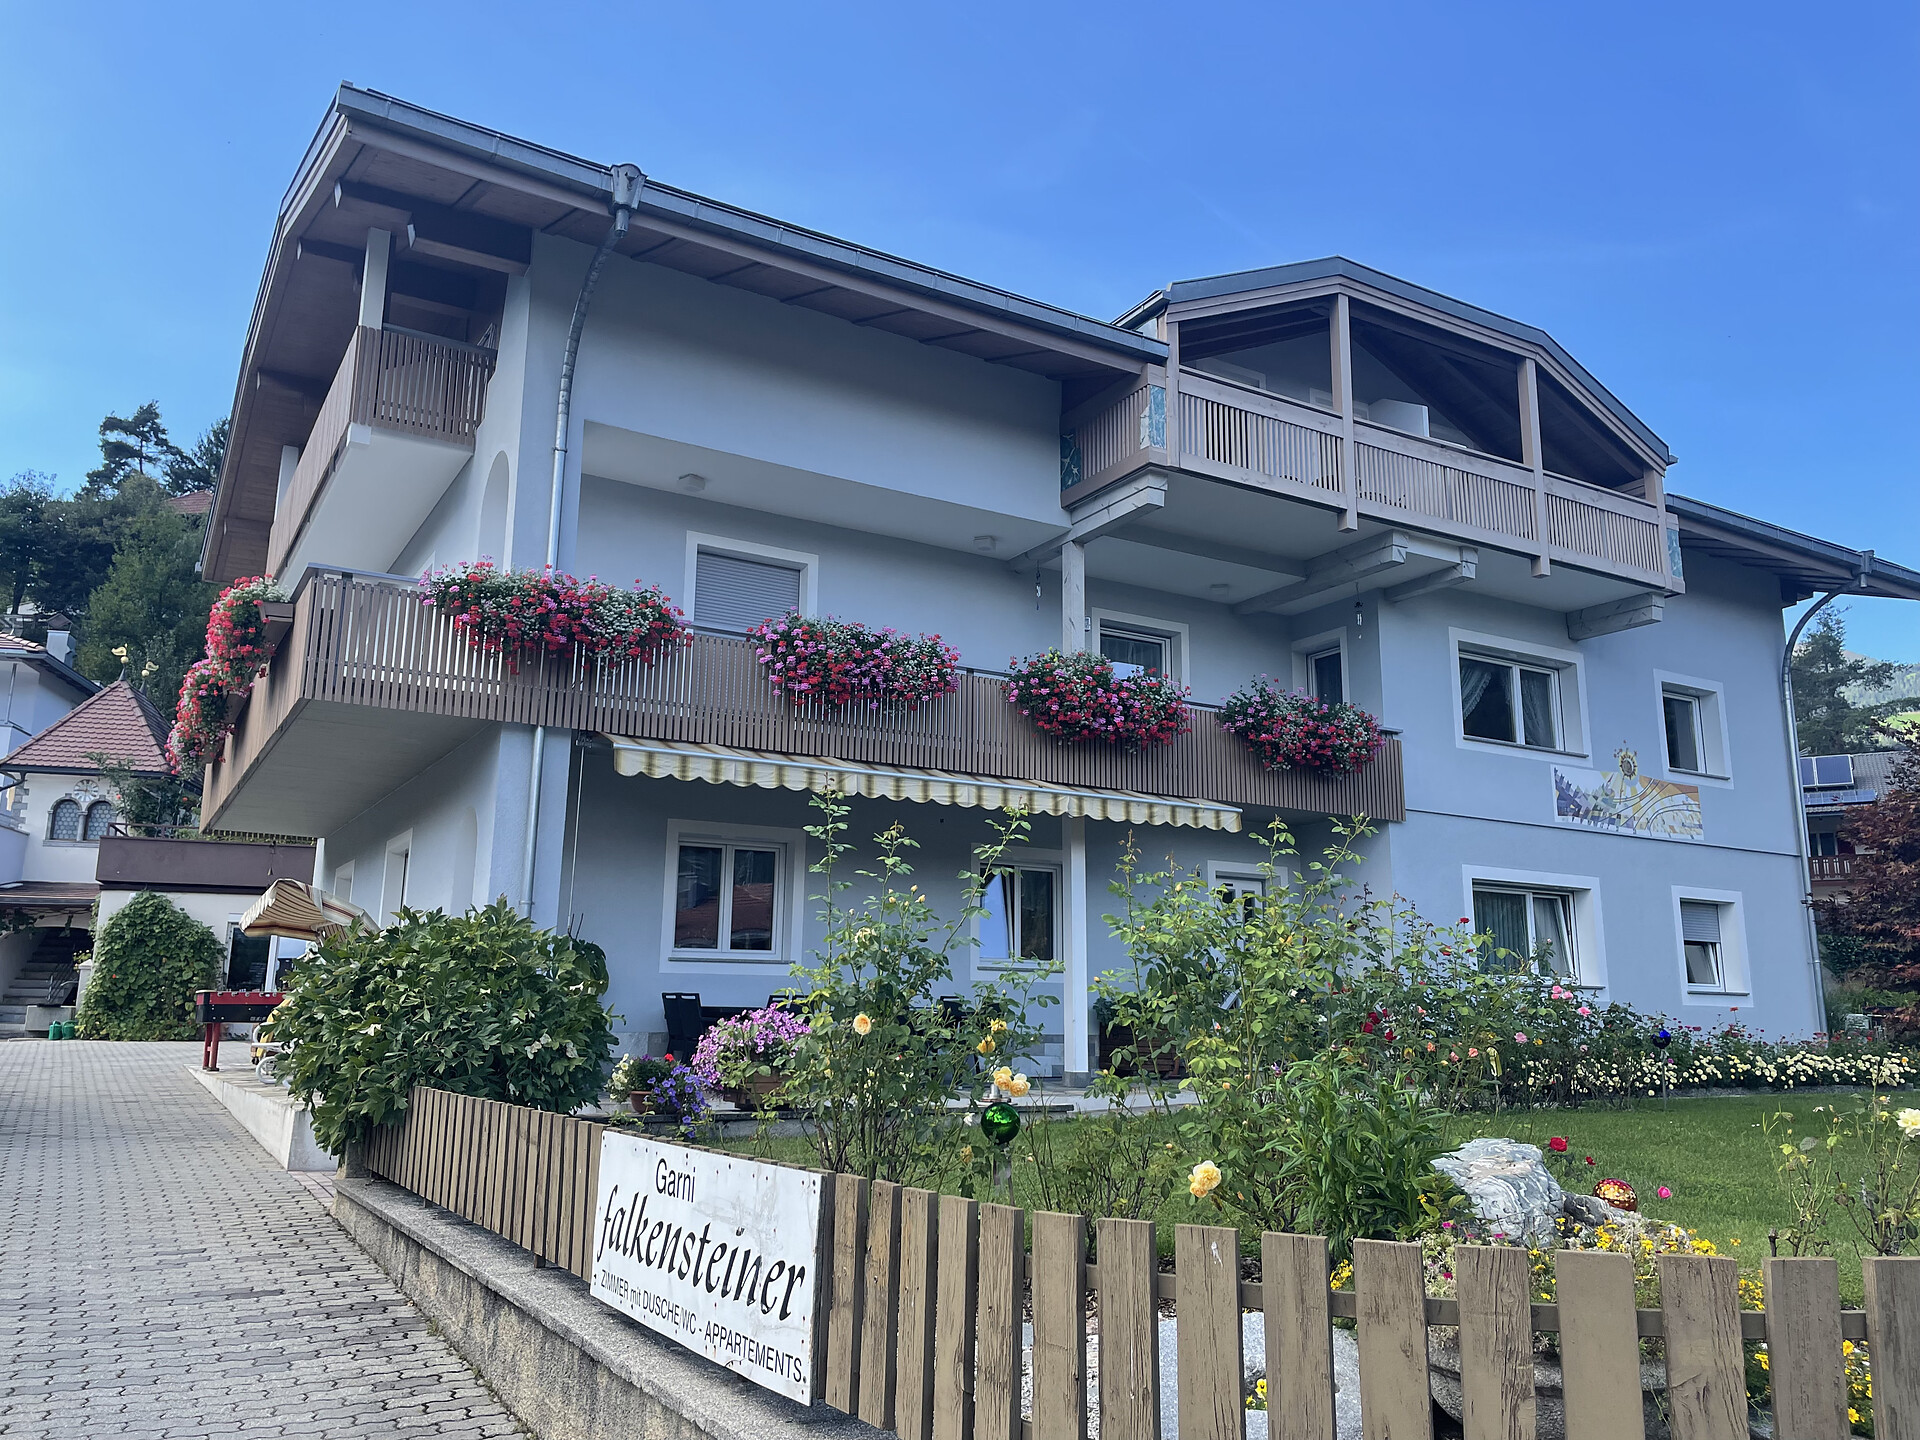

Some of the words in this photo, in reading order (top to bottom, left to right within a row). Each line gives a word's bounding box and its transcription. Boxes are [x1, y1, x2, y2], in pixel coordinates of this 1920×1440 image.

[656, 1158, 696, 1203] Garni
[596, 1184, 806, 1321] falkensteiner
[600, 1269, 629, 1300] ZIMMER
[630, 1287, 641, 1307] mit
